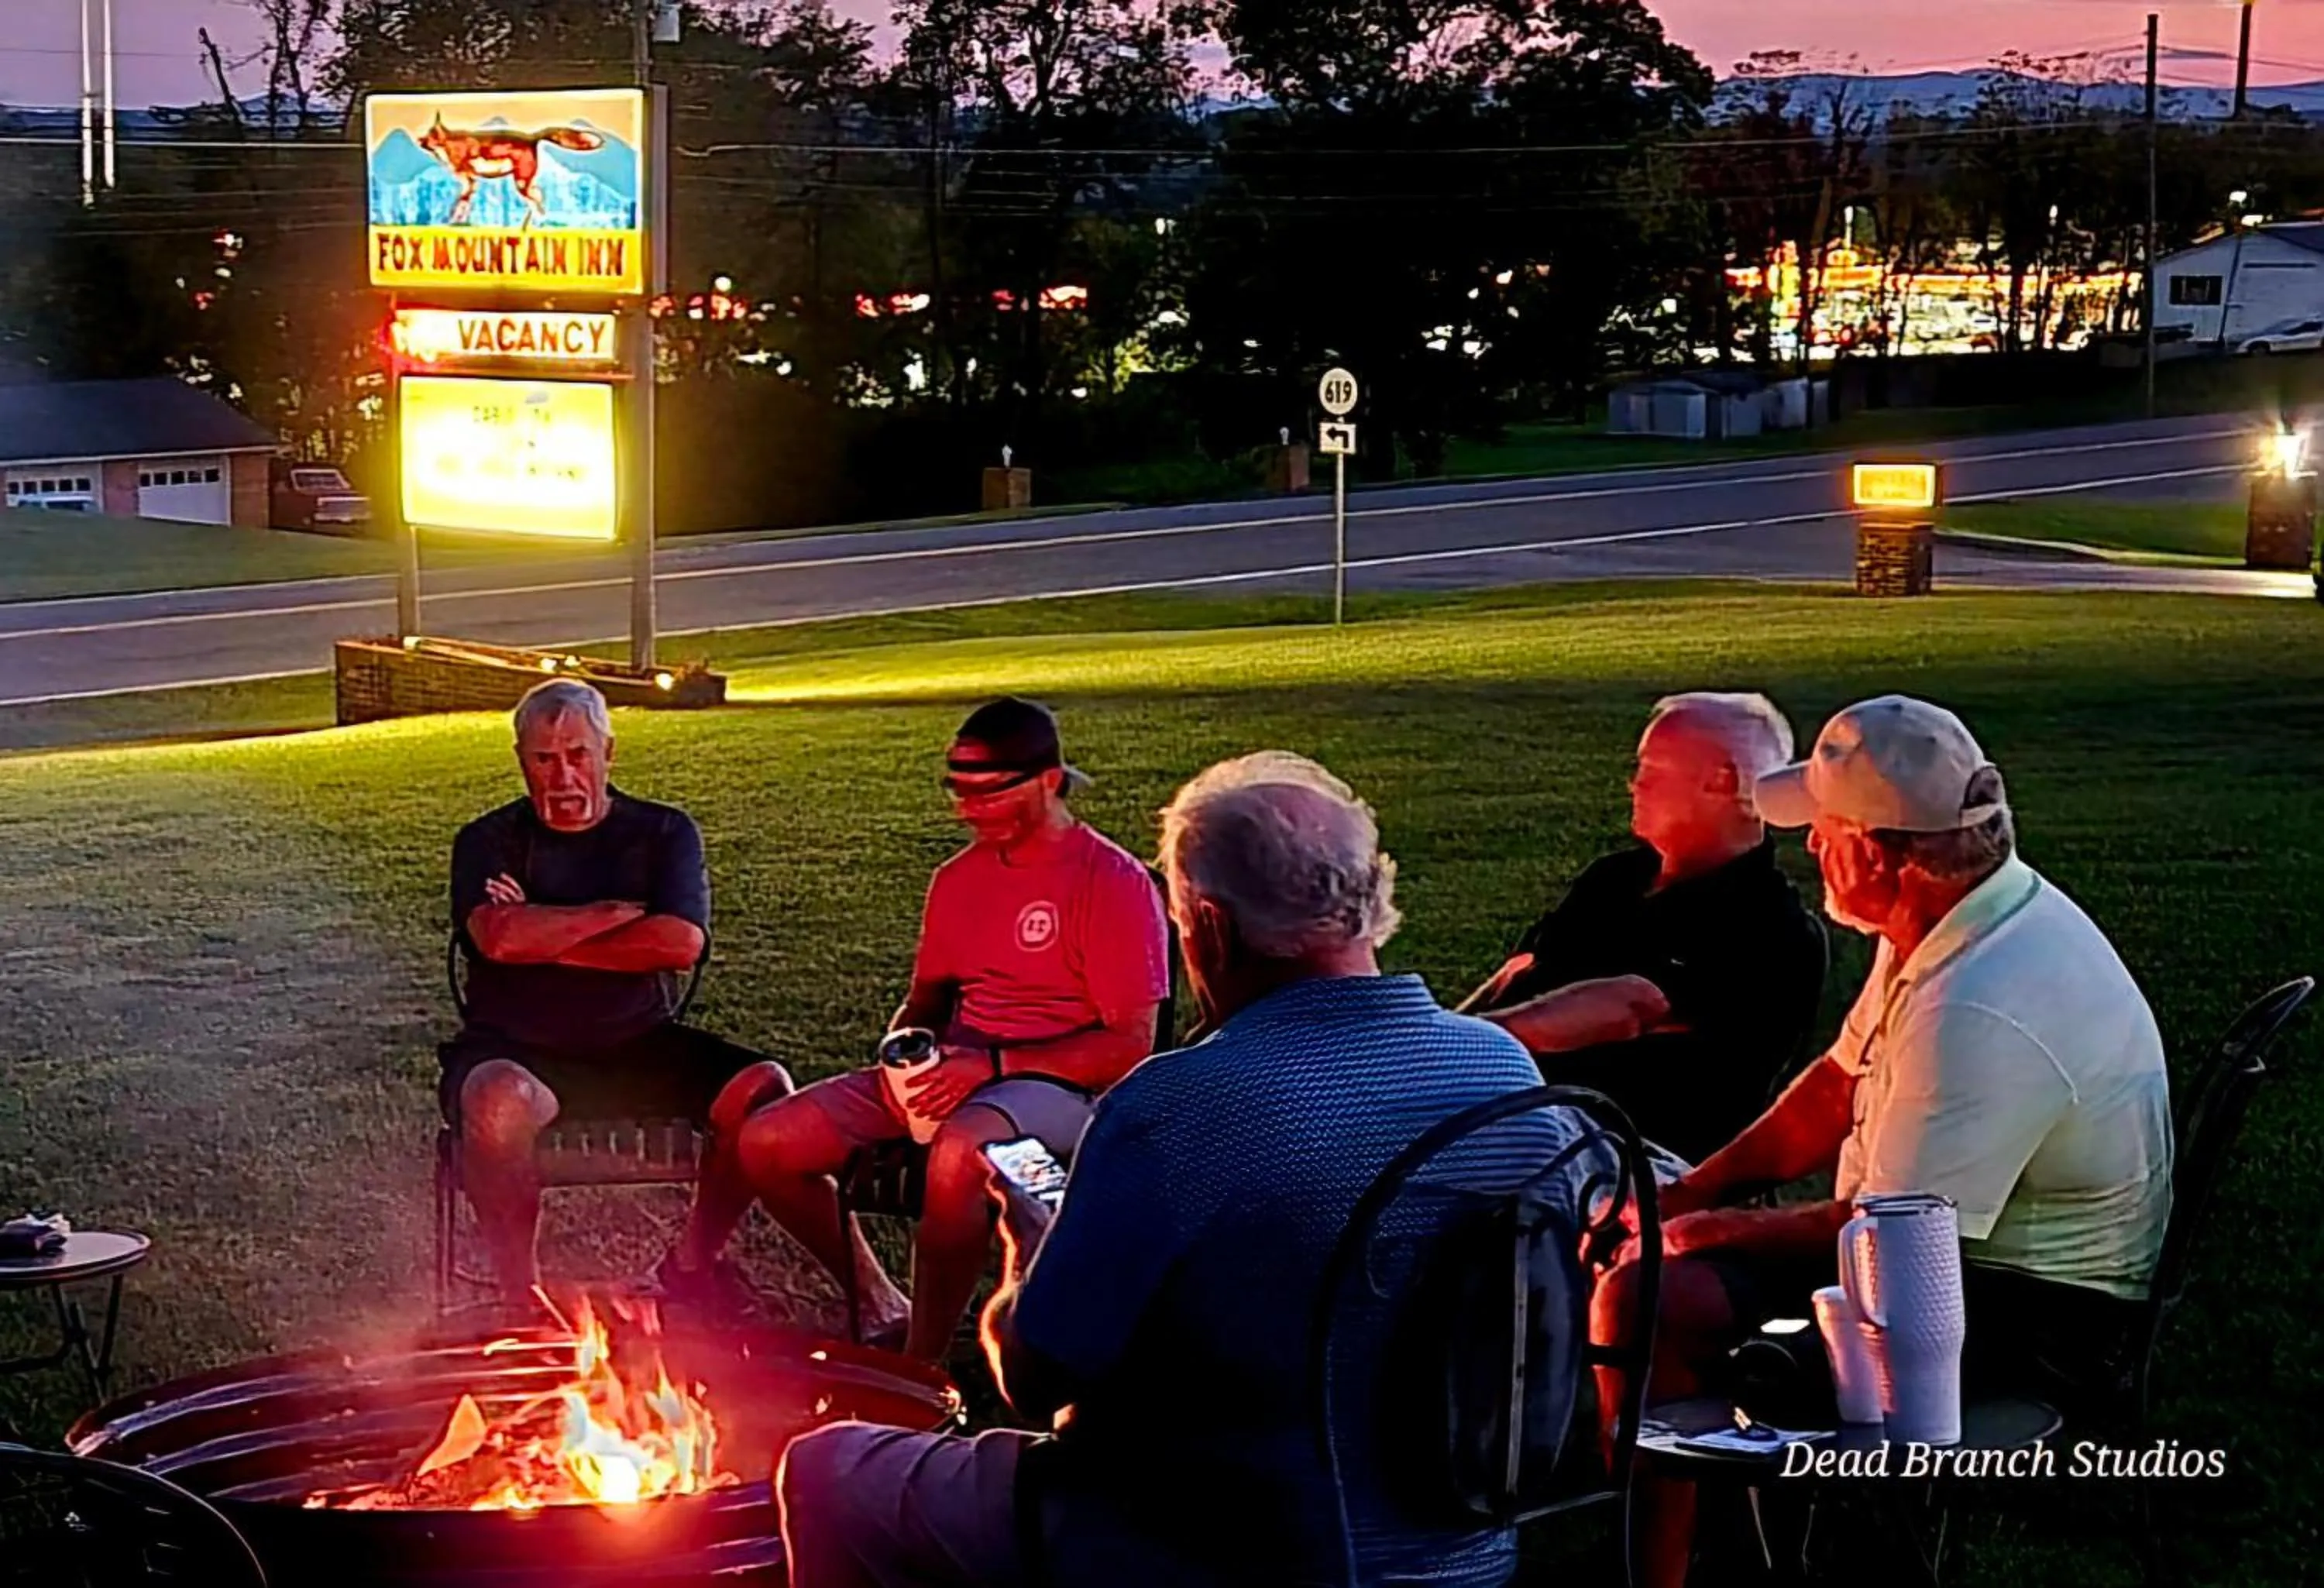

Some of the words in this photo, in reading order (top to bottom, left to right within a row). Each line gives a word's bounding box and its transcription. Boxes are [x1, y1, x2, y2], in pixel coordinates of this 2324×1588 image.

[376, 232, 424, 271] FOX
[432, 235, 568, 275] MOUNTAIN
[577, 237, 624, 277] INN
[457, 318, 606, 353] VACANCY
[1325, 380, 1353, 404] 619
